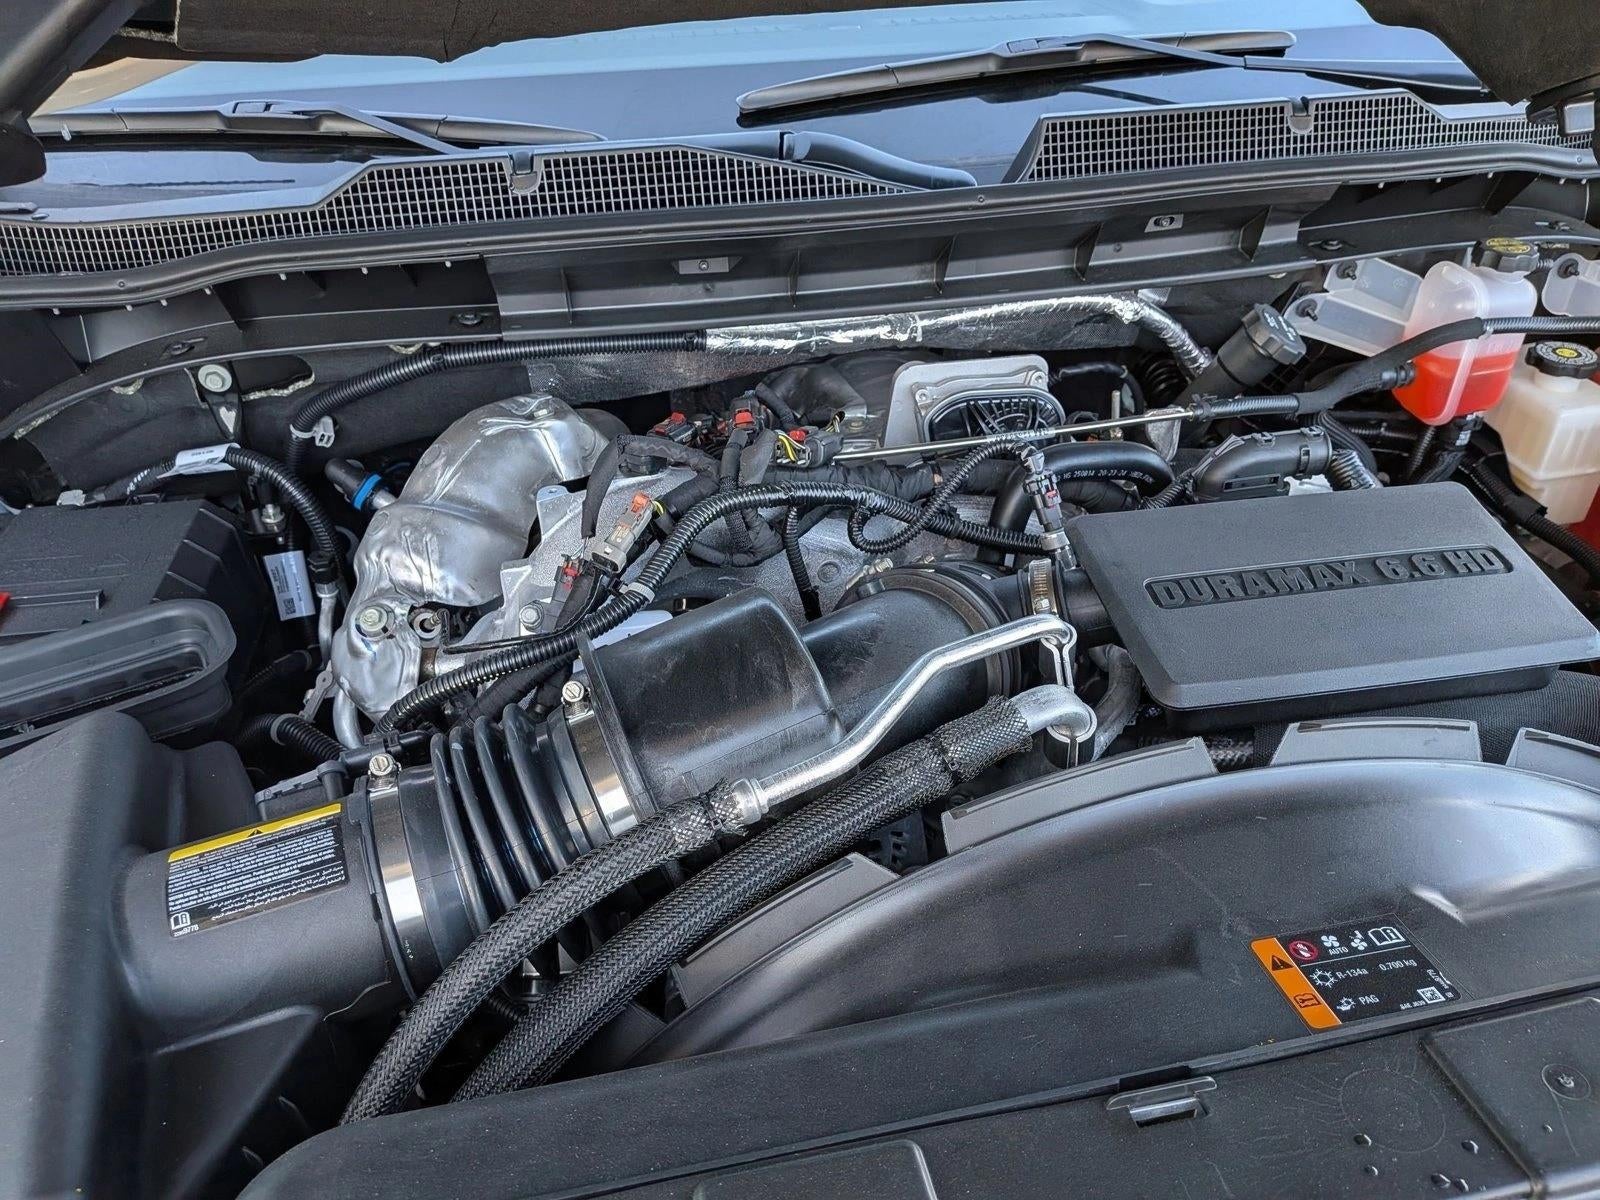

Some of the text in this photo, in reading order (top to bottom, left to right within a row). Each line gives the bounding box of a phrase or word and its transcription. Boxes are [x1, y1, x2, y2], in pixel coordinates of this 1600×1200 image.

[1153, 547, 1505, 607] DURAMAX 6.6 HD
[1329, 947, 1348, 955] AUTO
[1336, 959, 1417, 981] R-134a 0.700 kg
[1359, 995, 1379, 1005] PAG
